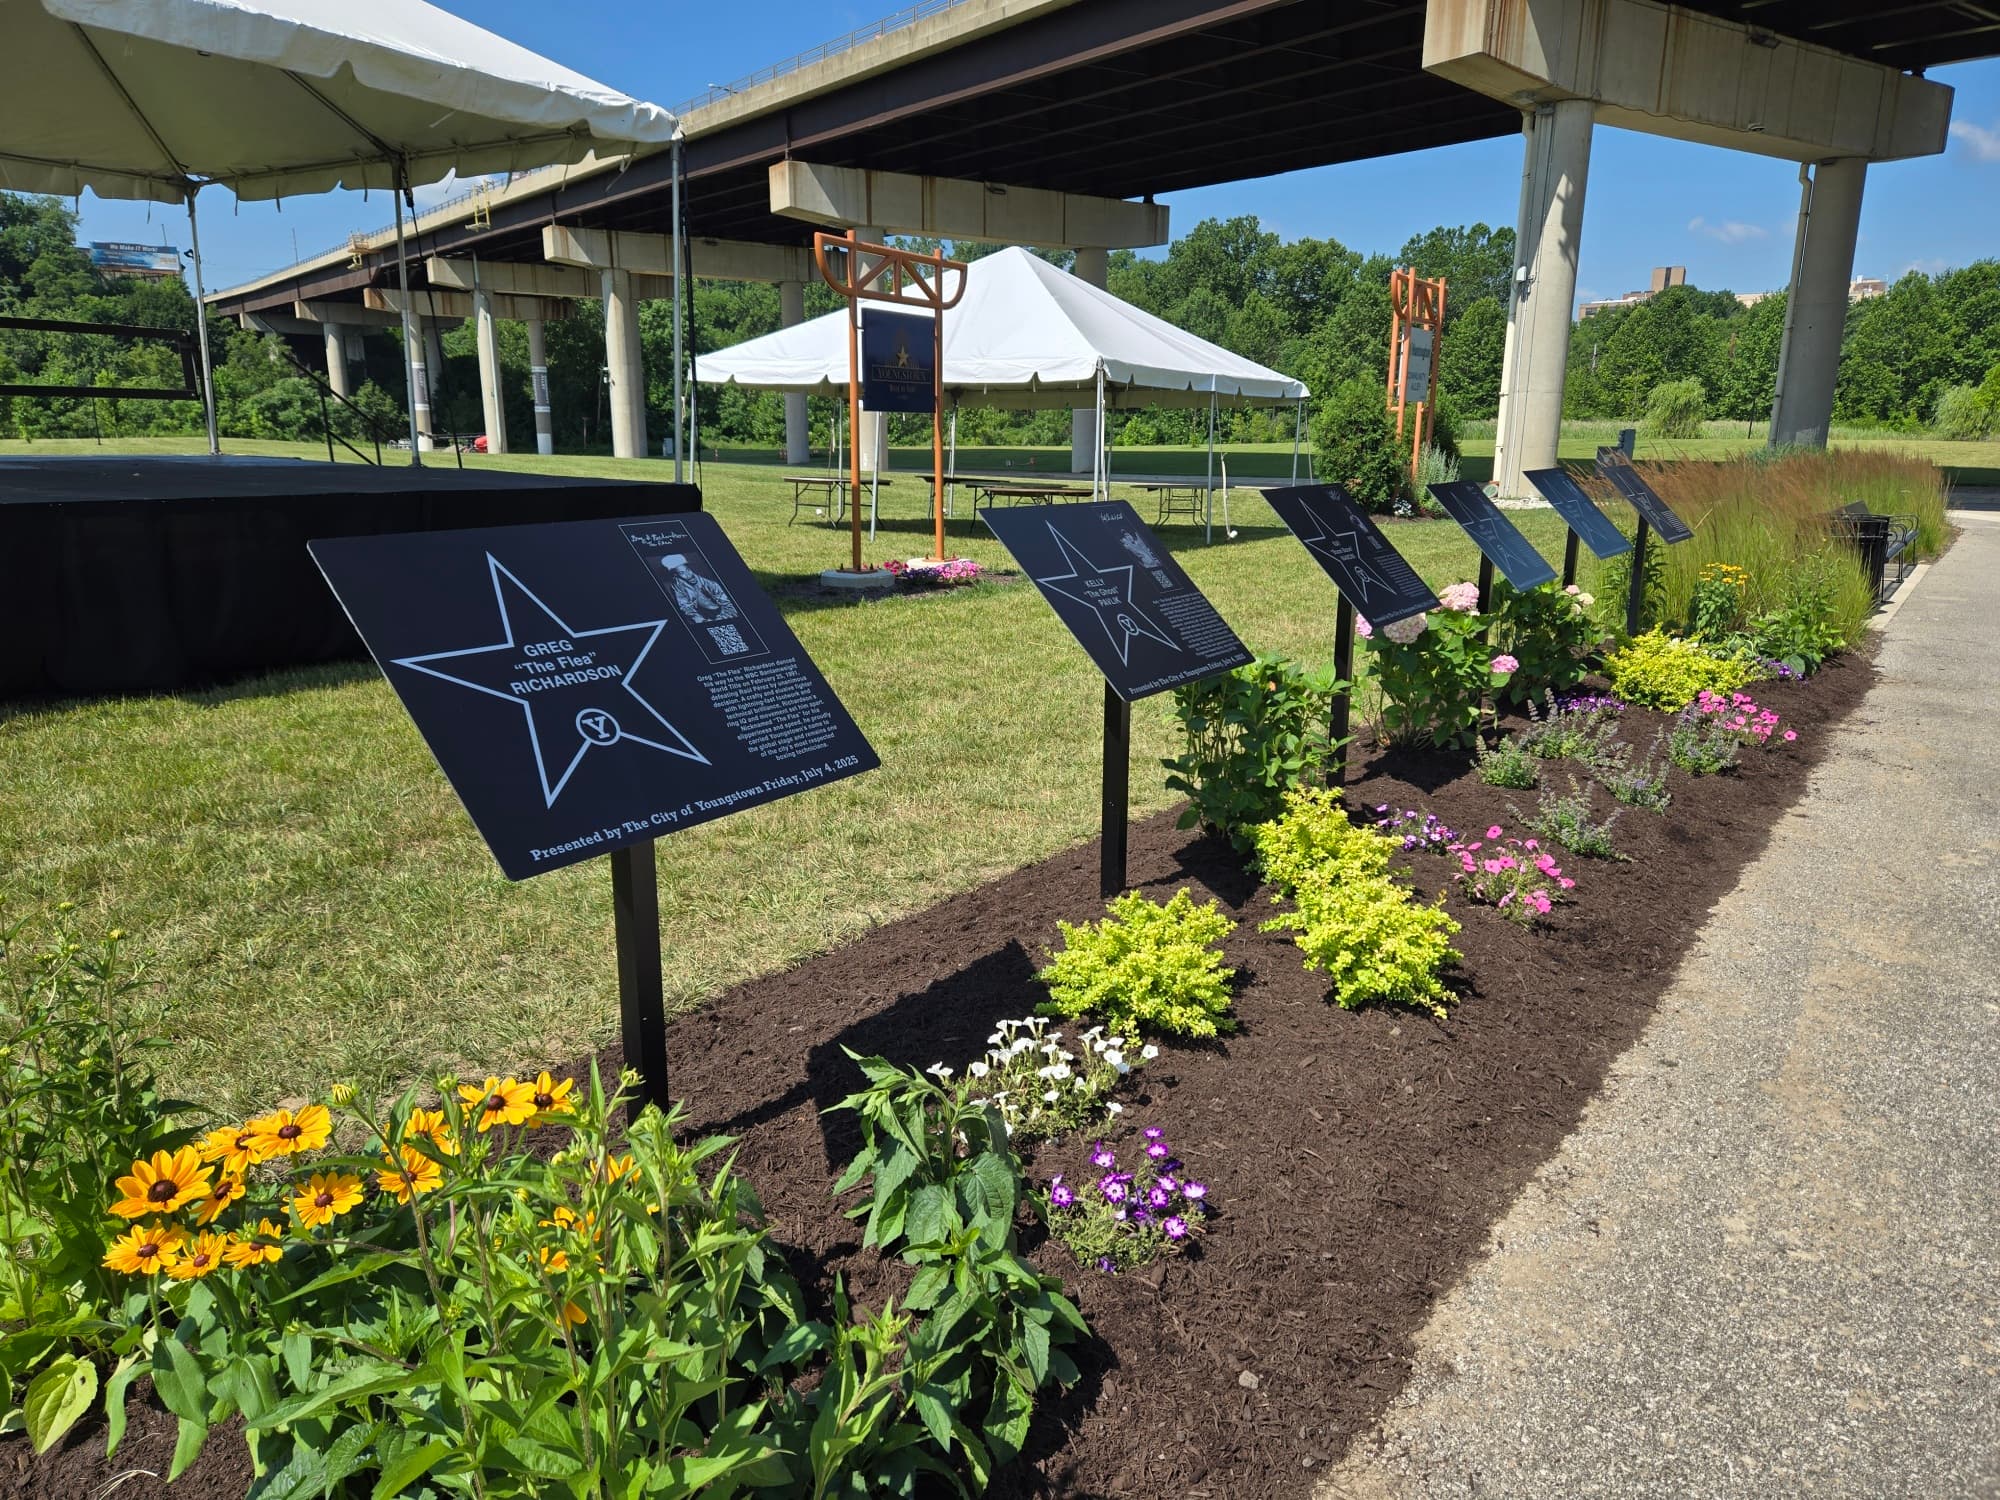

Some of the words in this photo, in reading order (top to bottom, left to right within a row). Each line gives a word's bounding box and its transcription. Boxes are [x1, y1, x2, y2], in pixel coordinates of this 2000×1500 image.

[524, 639, 574, 657] GREG
[514, 661, 556, 675] “The
[556, 651, 597, 670] Flea”
[510, 664, 622, 695] RICHARDSON
[581, 715, 610, 739] Y
[530, 835, 603, 861] Presented
[605, 828, 622, 844] by
[622, 817, 650, 834] The
[650, 809, 679, 825] City
[680, 804, 695, 817] of
[695, 787, 763, 811] Youngstown
[764, 774, 803, 795] Friday,
[801, 766, 824, 783] July
[824, 762, 837, 776] 4,
[834, 755, 859, 770] 2025
